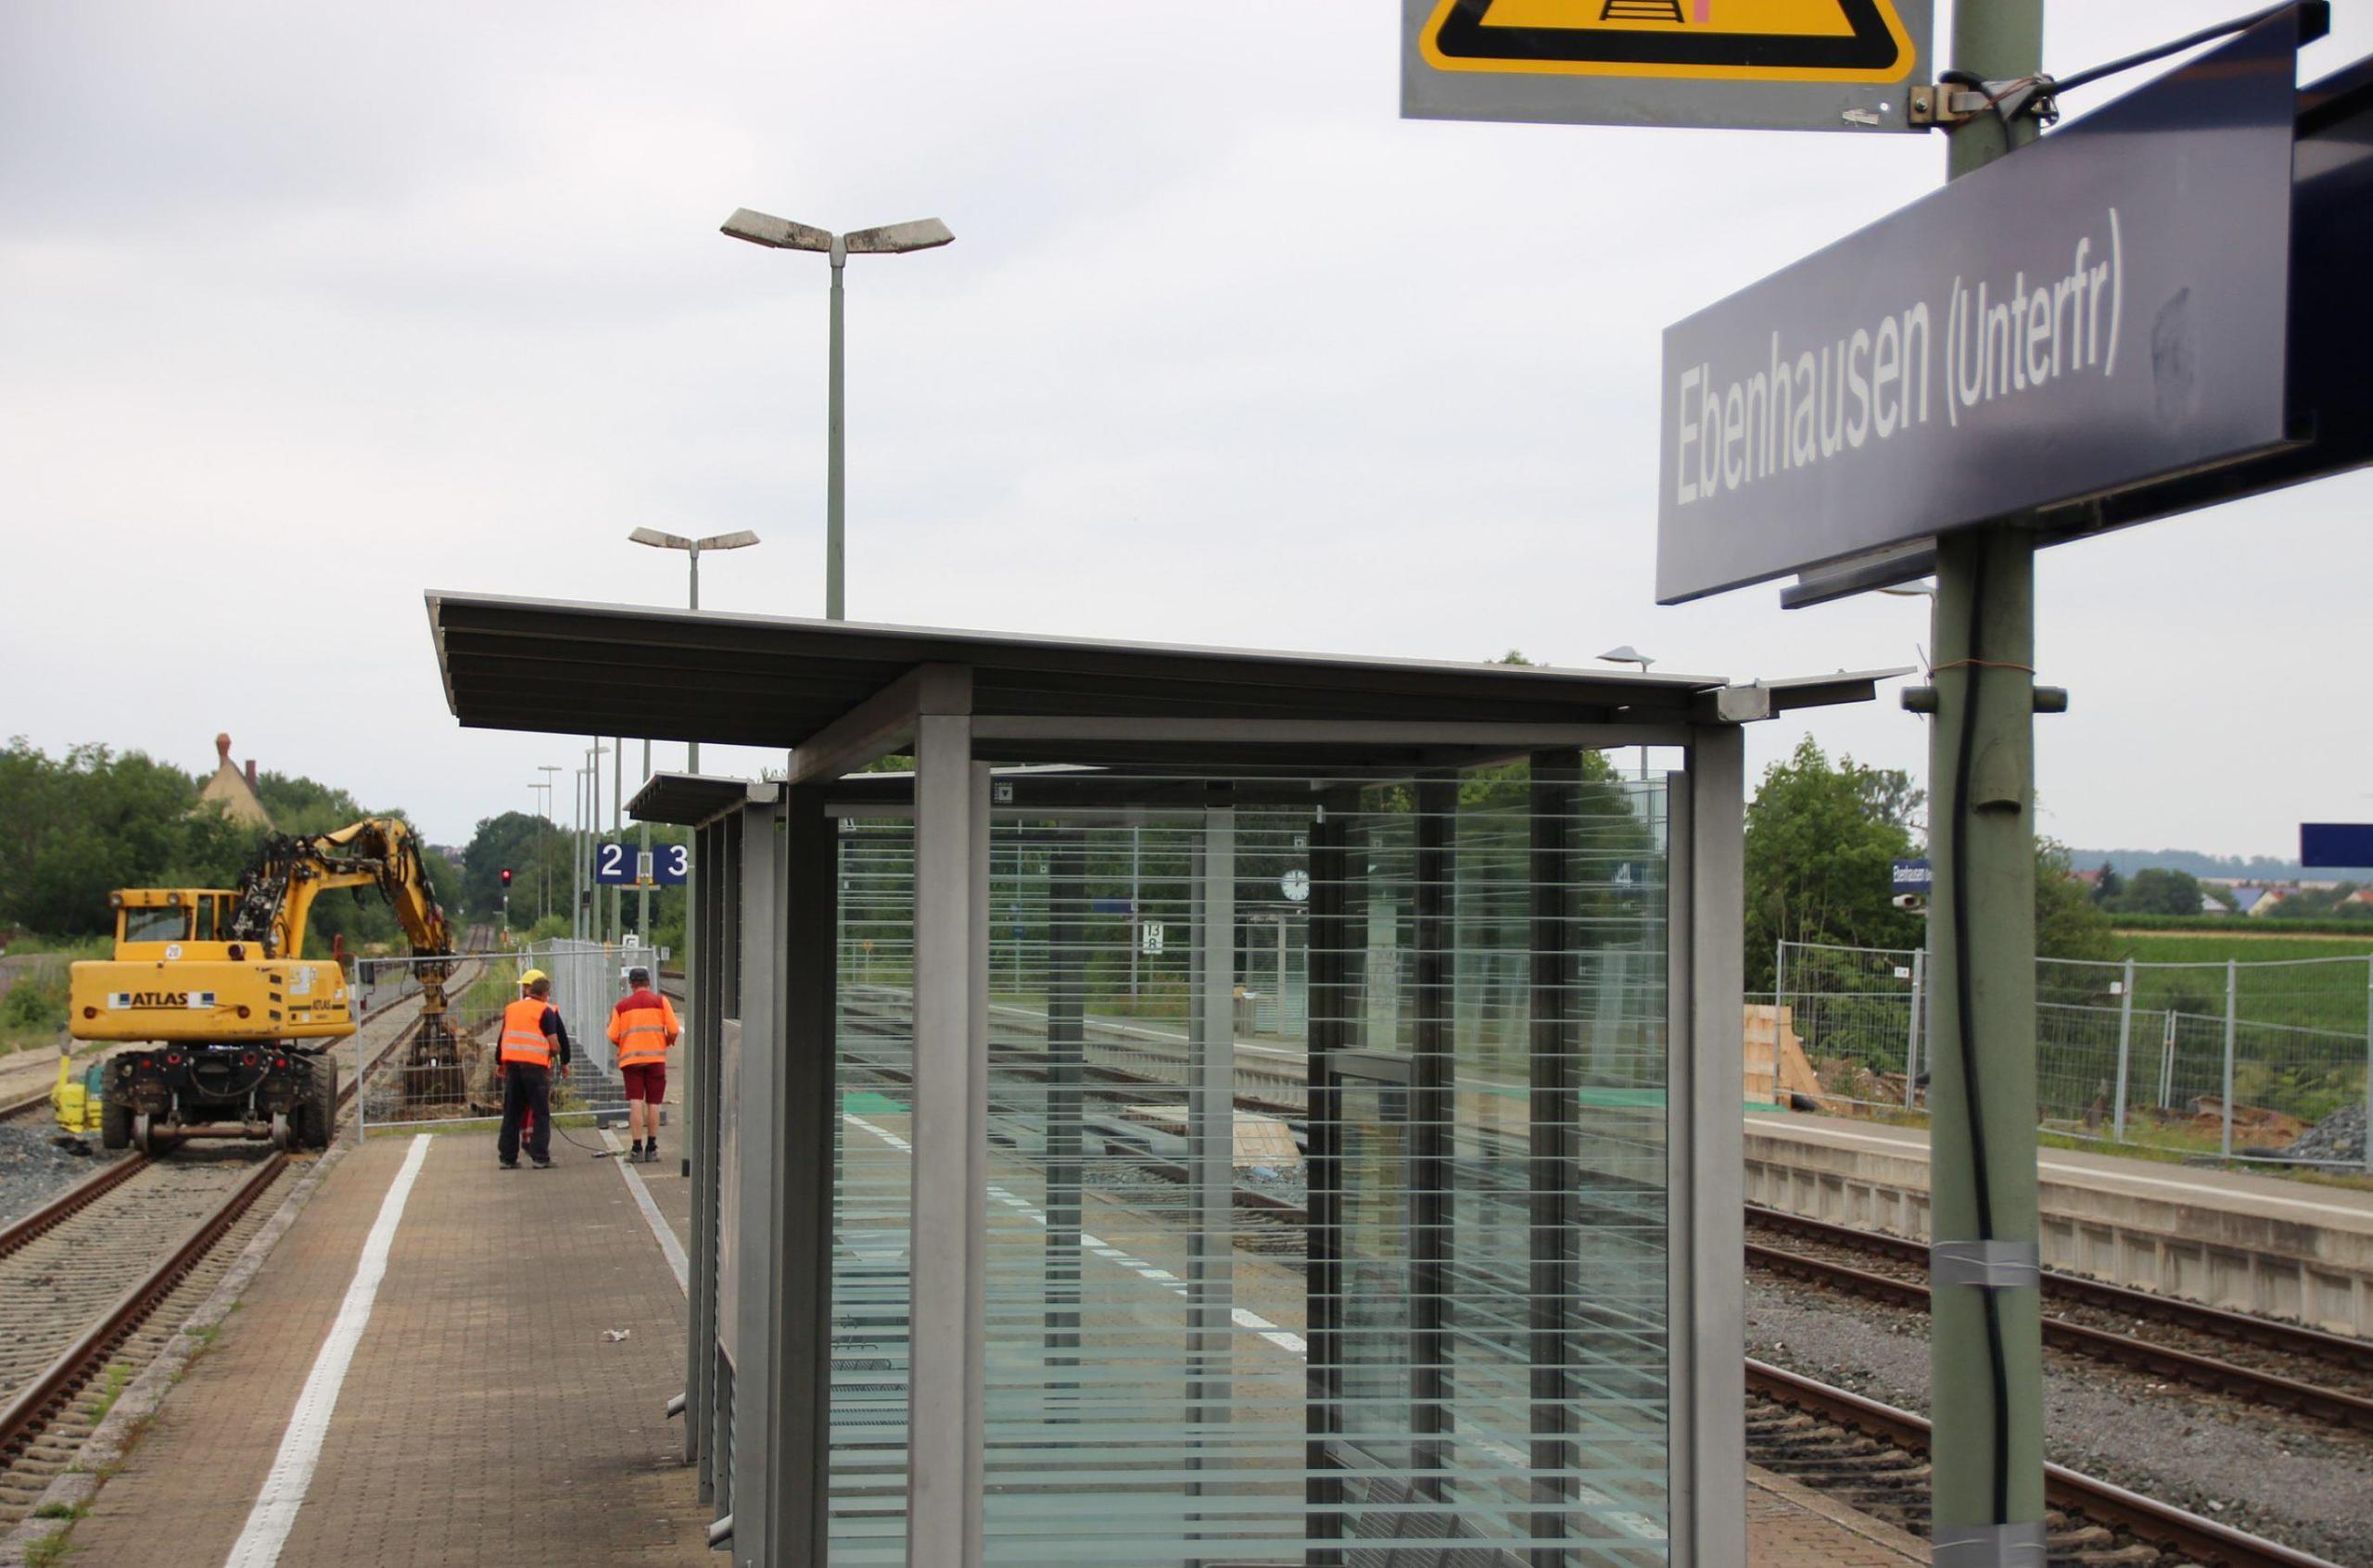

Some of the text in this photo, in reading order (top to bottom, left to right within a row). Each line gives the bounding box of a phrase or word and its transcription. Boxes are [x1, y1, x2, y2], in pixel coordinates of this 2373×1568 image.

[1676, 207, 2124, 505] Ebenhausen (Unterfr)
[602, 844, 623, 876] 2
[667, 844, 688, 877] 3
[1148, 922, 1160, 937] 13
[132, 992, 188, 1005] ATLAS
